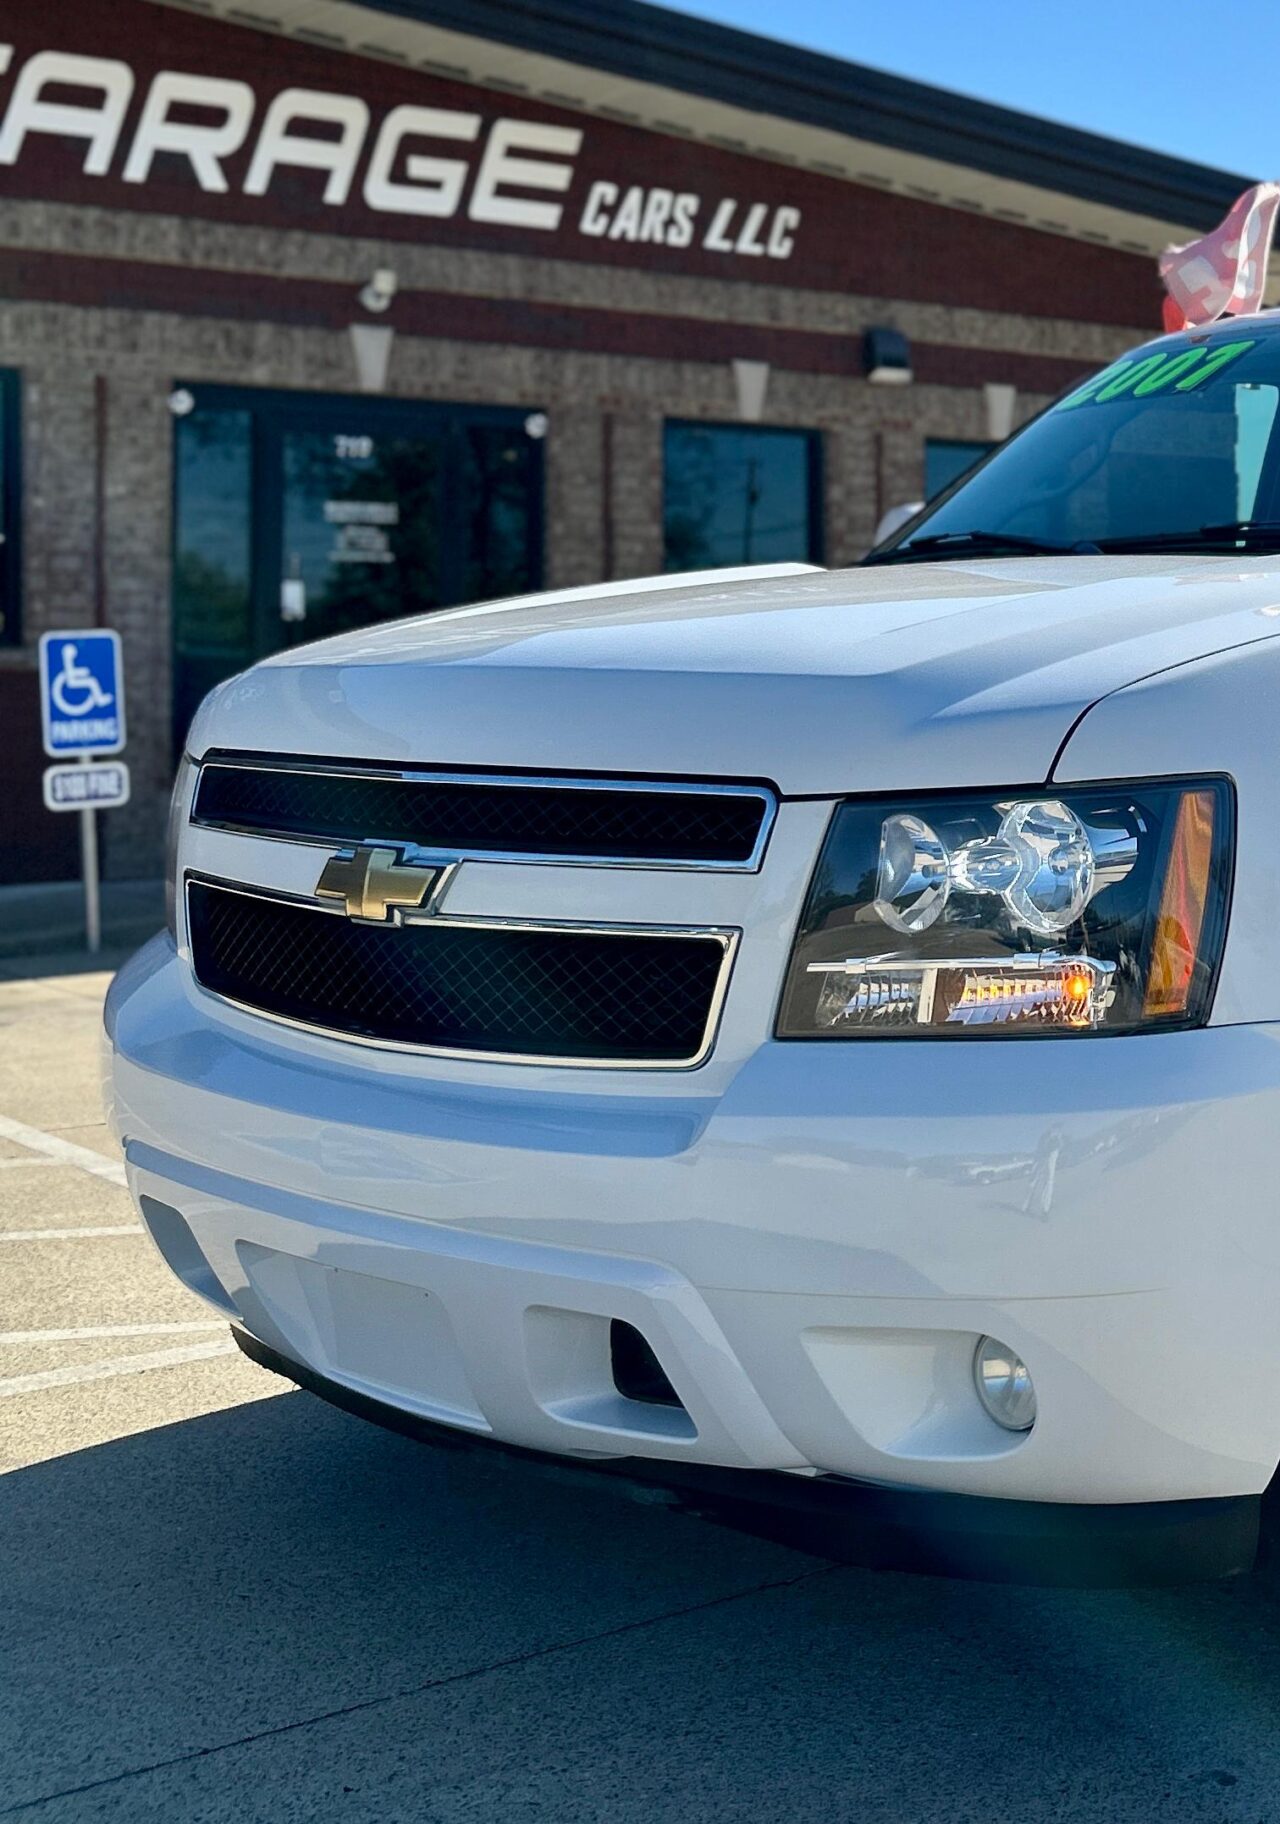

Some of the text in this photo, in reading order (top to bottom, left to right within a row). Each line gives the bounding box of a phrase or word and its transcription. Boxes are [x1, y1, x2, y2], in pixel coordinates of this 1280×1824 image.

[0, 43, 801, 260] ARAGE CARS LLC
[1056, 340, 1256, 411] 2007
[51, 717, 118, 744] PARKING
